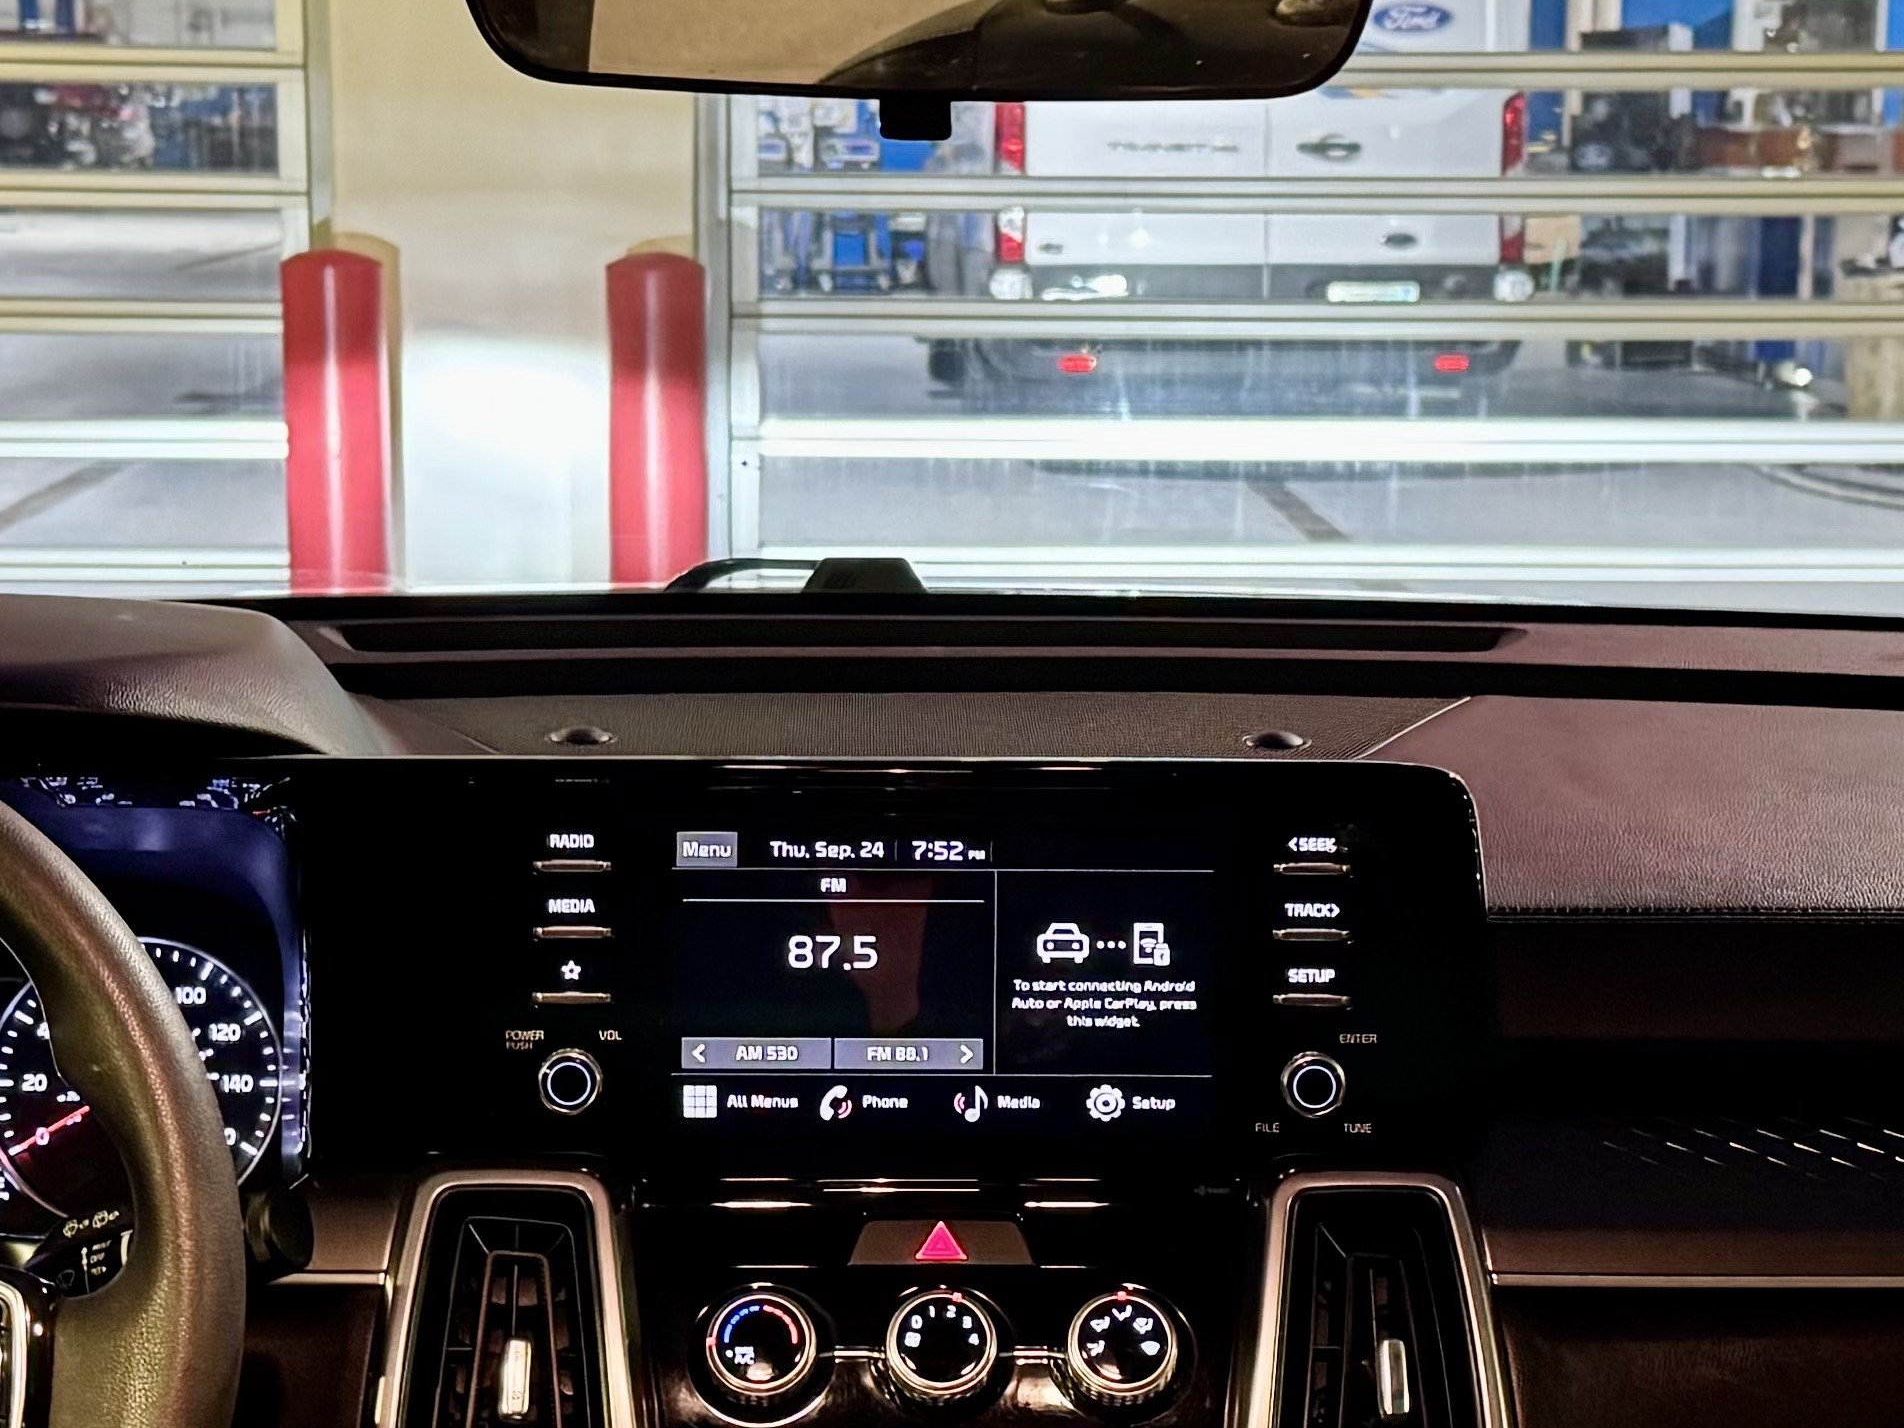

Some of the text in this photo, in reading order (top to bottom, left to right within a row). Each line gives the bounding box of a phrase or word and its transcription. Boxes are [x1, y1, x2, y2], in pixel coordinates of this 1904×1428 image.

[549, 834, 595, 849] RADIO
[682, 842, 732, 858] Menu
[769, 841, 810, 859] Thu.
[814, 841, 855, 861] Sep.
[860, 841, 885, 858] 24
[911, 840, 964, 861] 7:52
[820, 878, 847, 893] FM
[548, 899, 596, 914] MEDIA
[787, 935, 879, 971] 87.5
[1287, 968, 1336, 983] SETUP
[1013, 979, 1196, 995] To start connecting Android
[175, 986, 207, 1005] 100
[1012, 997, 1044, 1010] Auto
[1046, 999, 1062, 1010] or
[1063, 997, 1102, 1012] Apple
[1159, 999, 1197, 1012] press
[1067, 1015, 1093, 1027] this
[209, 1024, 241, 1042] 120
[505, 1030, 544, 1041] POWER
[599, 1031, 622, 1041] VOL
[1339, 1034, 1378, 1044] ENTER
[735, 1046, 799, 1061] AM 530
[867, 1046, 892, 1061] FM
[21, 1074, 48, 1092] 20
[221, 1074, 254, 1093] 140
[727, 1095, 799, 1109] All Menus
[862, 1095, 908, 1109] Phone
[997, 1095, 1041, 1110] Media
[1132, 1096, 1176, 1112] Setup
[1255, 1123, 1280, 1133] FILE
[1343, 1123, 1372, 1133] TUNE
[35, 1127, 50, 1146] 0
